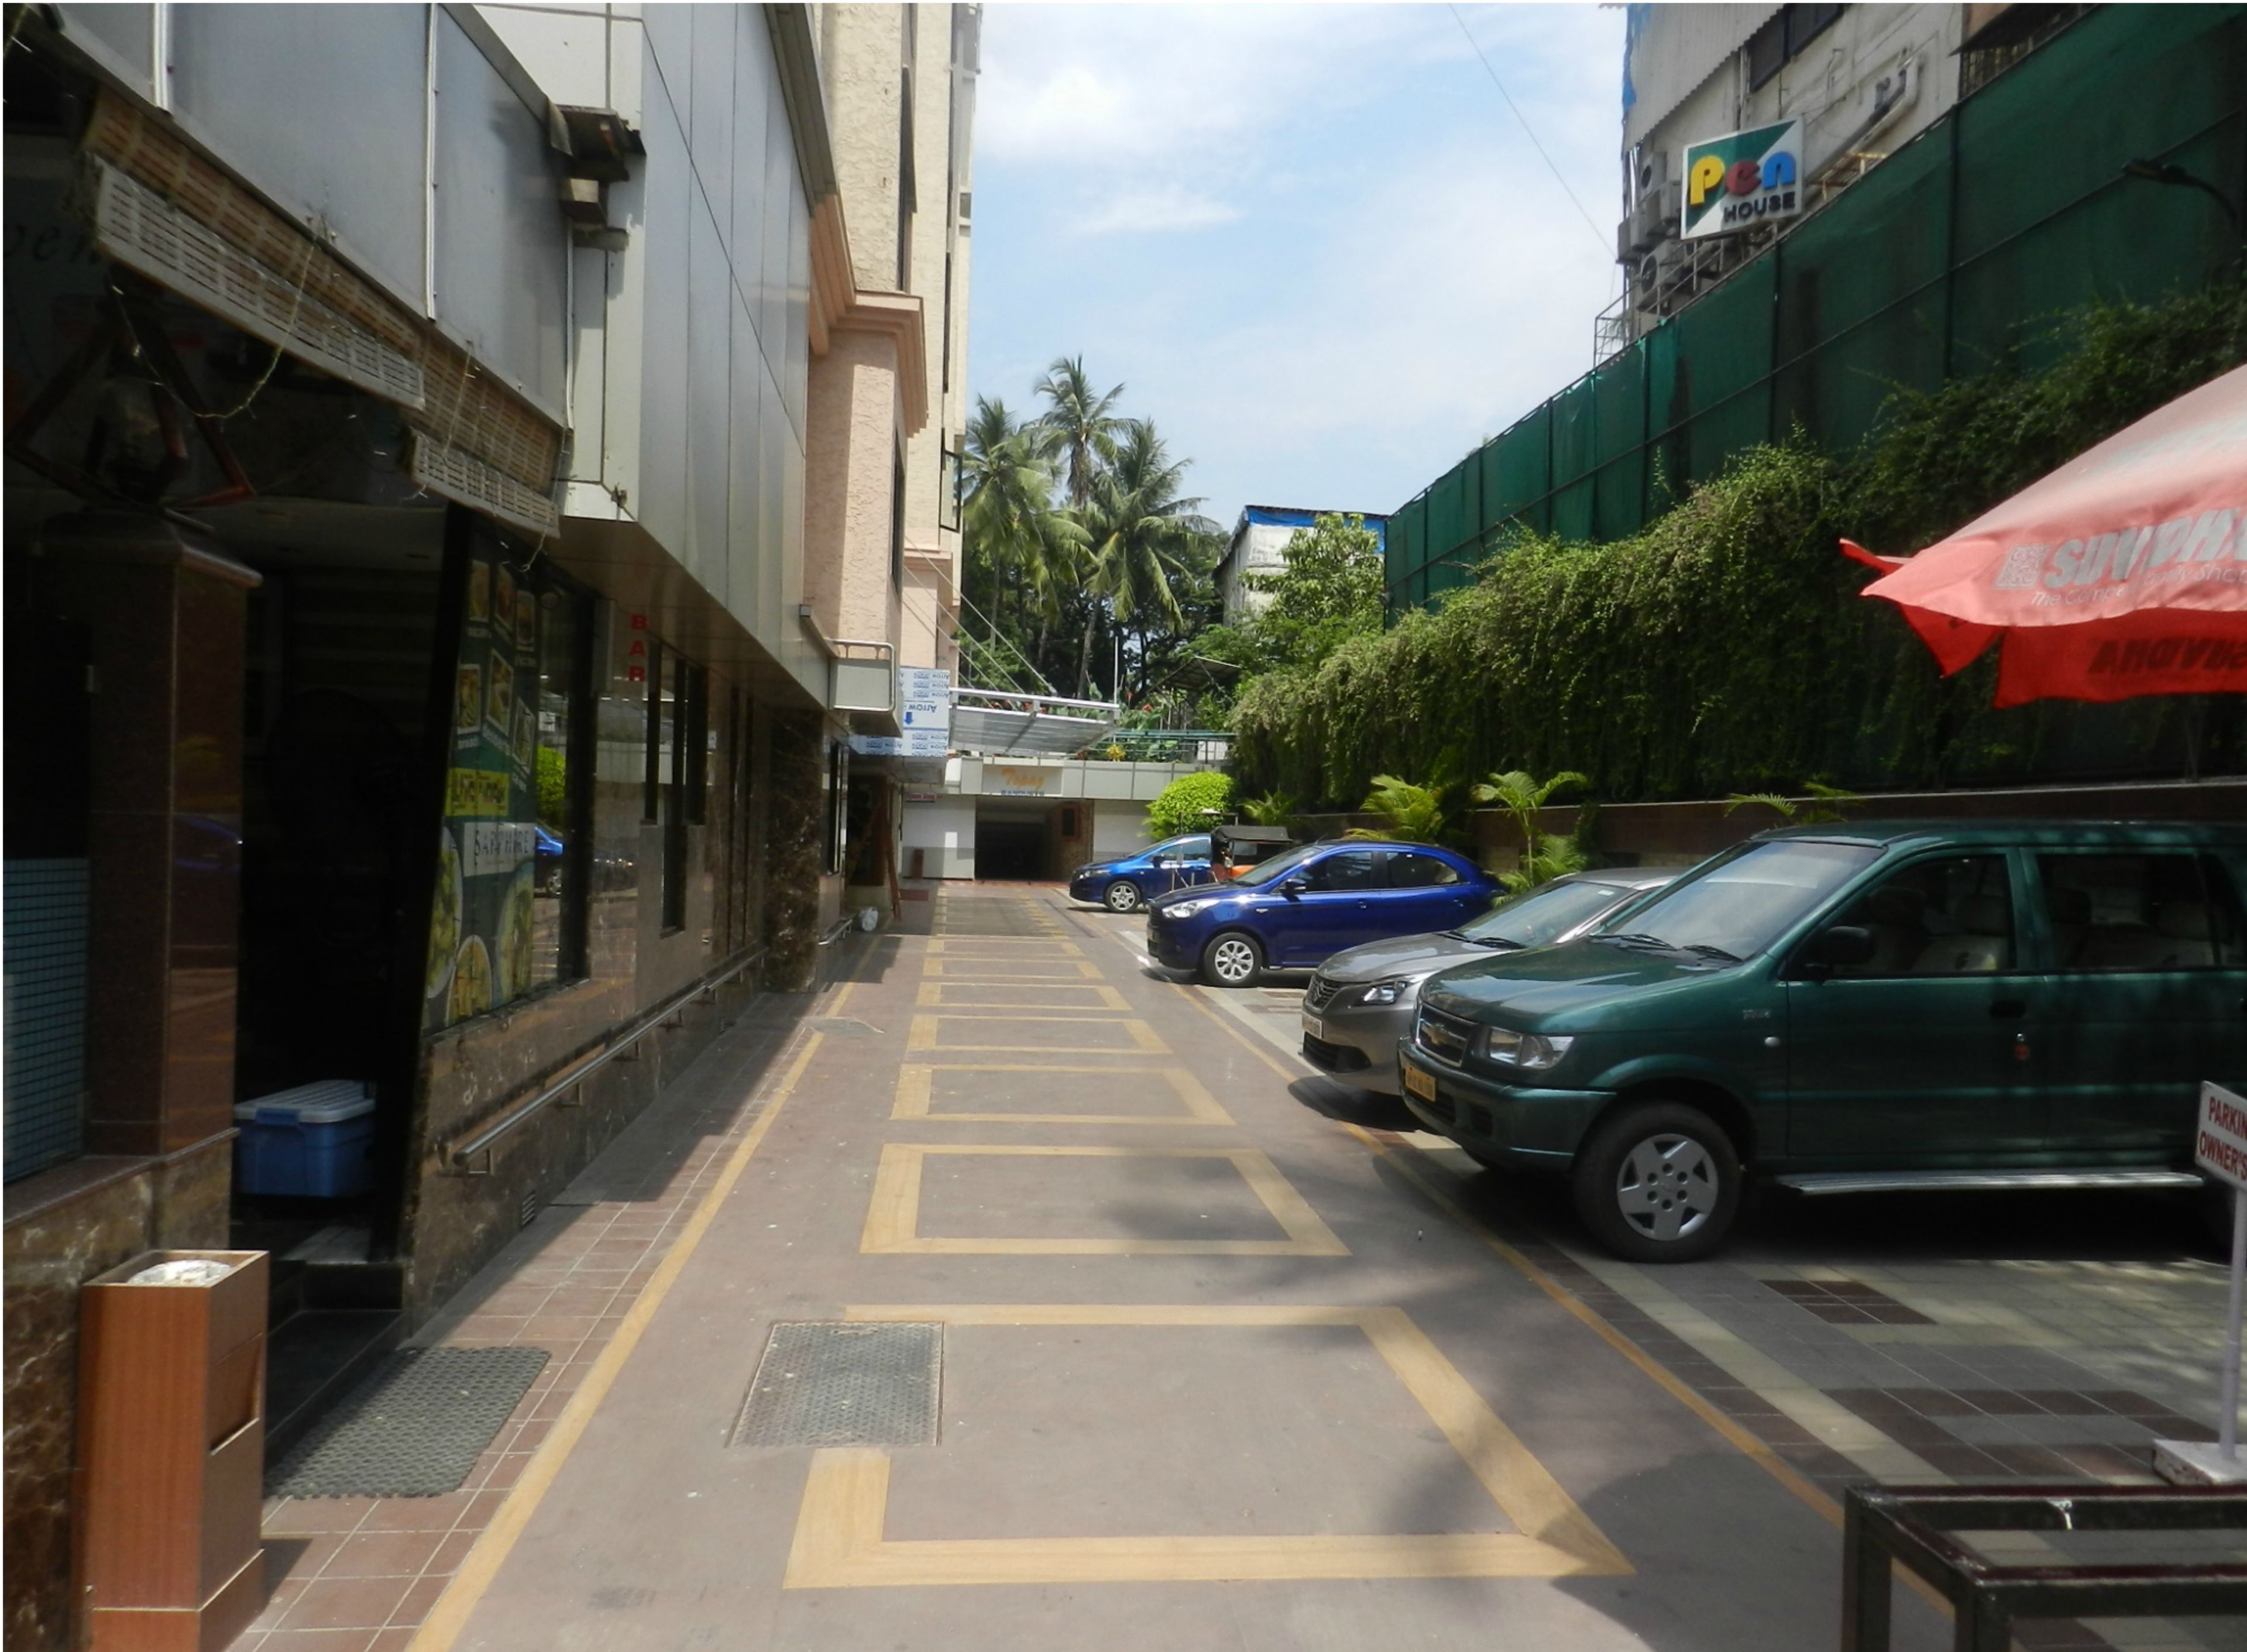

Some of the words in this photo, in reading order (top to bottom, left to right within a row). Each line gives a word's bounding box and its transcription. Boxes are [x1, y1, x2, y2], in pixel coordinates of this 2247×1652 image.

[1723, 191, 1795, 222] HOUSE
[628, 613, 648, 682] BAR
[909, 704, 937, 713] Arrow
